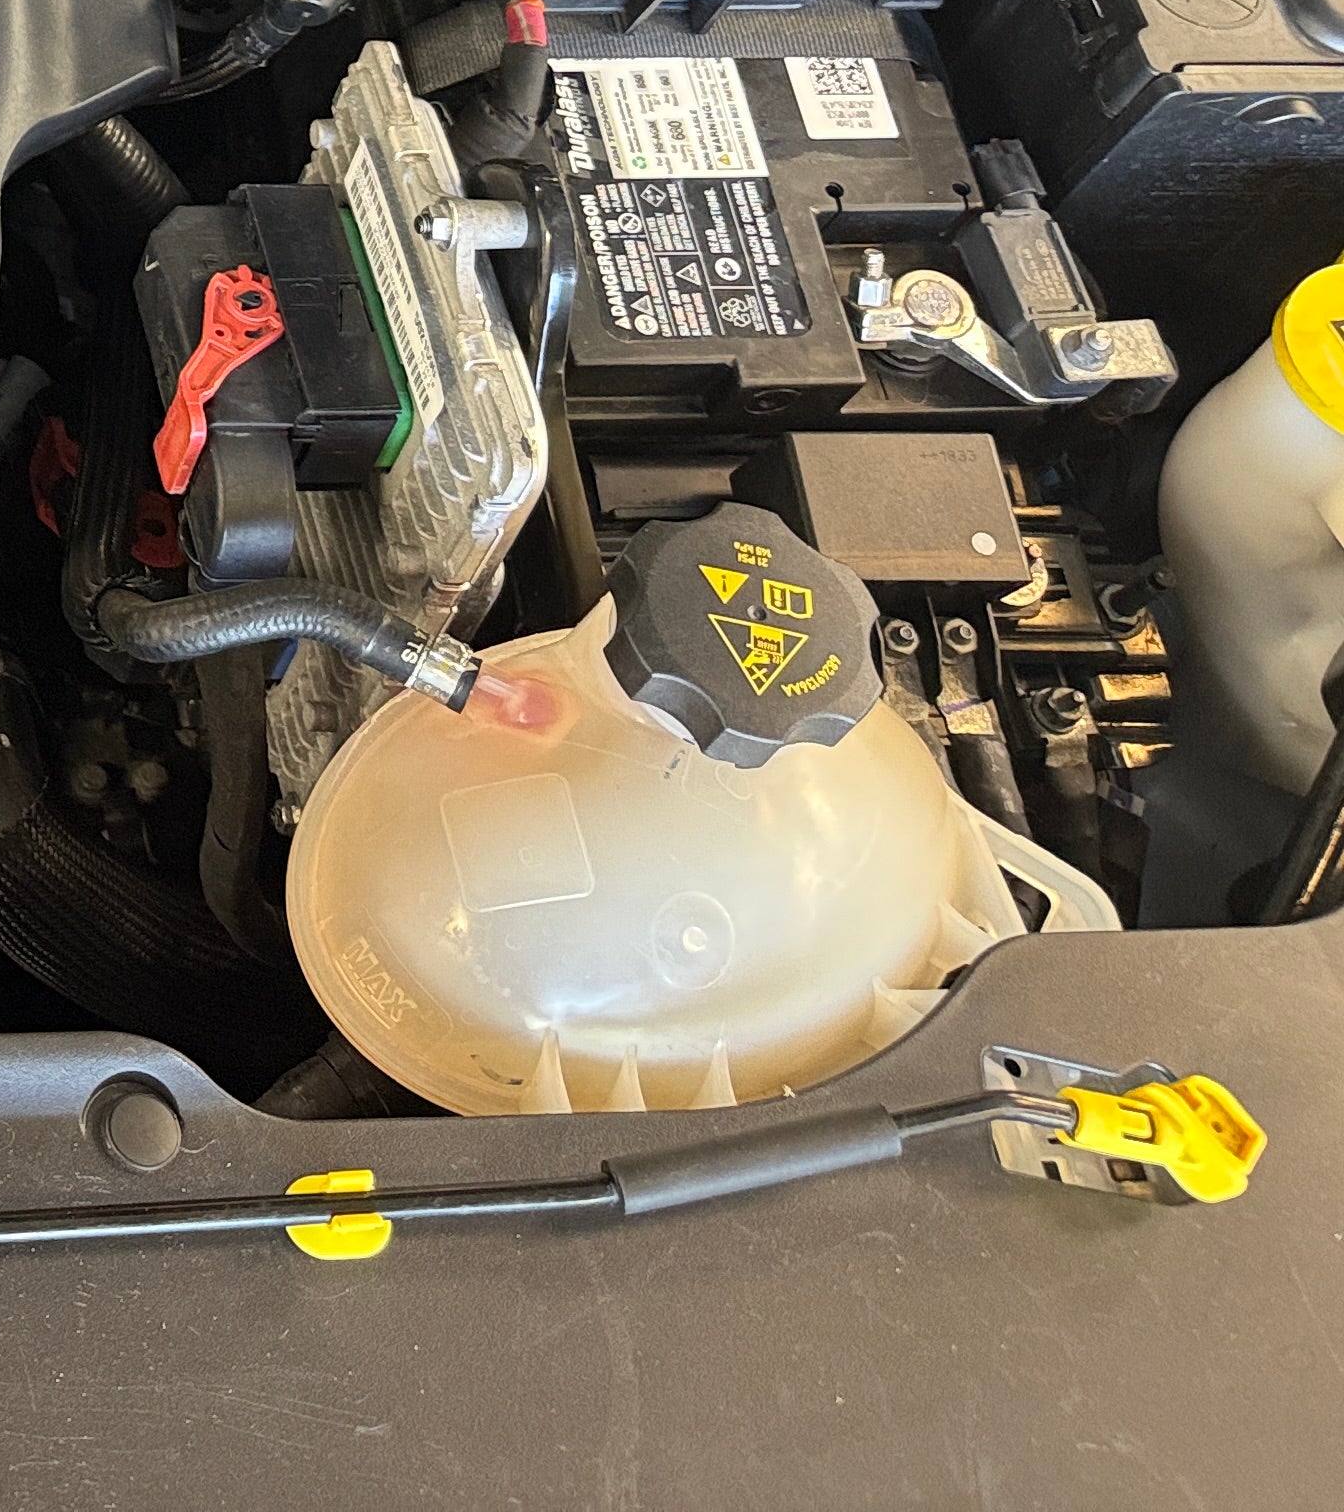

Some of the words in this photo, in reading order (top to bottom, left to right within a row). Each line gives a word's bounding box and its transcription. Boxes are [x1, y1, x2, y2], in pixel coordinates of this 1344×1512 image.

[591, 75, 615, 142] TECHNOLOGY
[554, 76, 596, 173] Duralast
[702, 102, 723, 152] WARNING:
[610, 146, 622, 170] AGM
[605, 220, 621, 233] NO
[705, 229, 720, 253] READ
[750, 236, 765, 264] REACH
[580, 194, 627, 317] DANGER/POISON
[756, 265, 770, 281] THE
[766, 297, 780, 313] OUT
[772, 315, 787, 335] KEEP
[342, 935, 418, 1024] MAX
